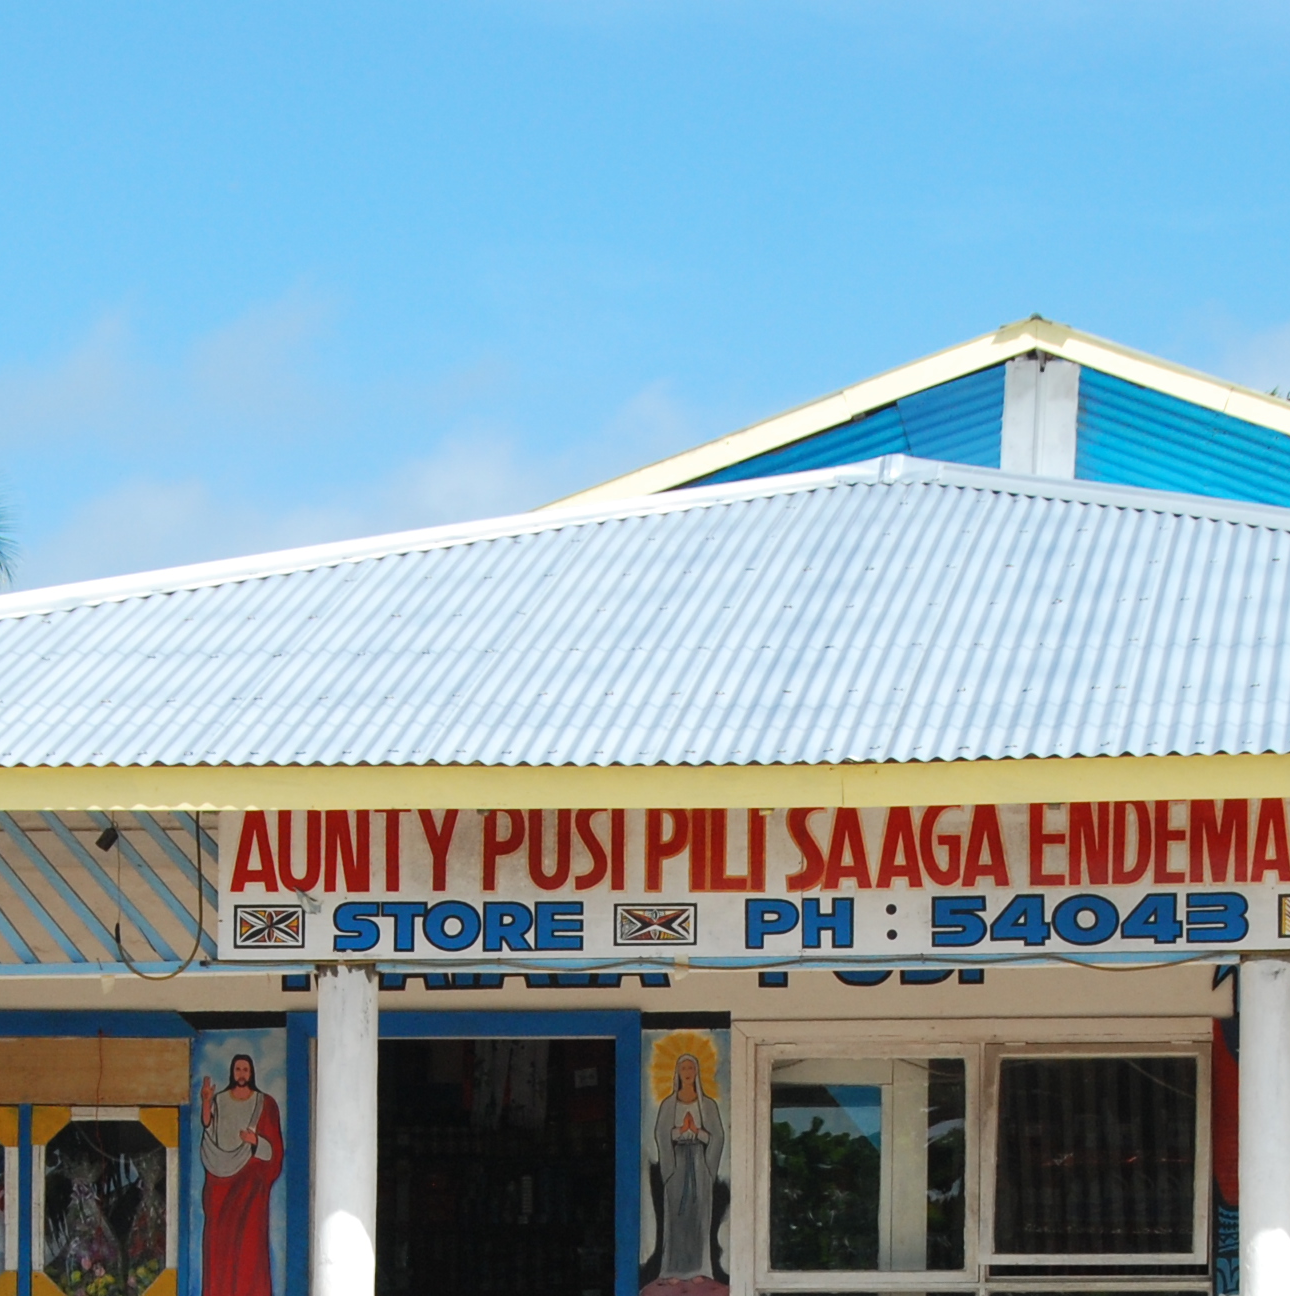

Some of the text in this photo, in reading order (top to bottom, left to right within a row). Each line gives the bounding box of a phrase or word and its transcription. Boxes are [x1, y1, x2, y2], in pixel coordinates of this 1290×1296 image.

[230, 809, 460, 893] AUNTY
[481, 808, 626, 892] PUSI
[645, 807, 767, 893] PILI
[785, 803, 1010, 892] SAAGA
[333, 900, 584, 953] STORE
[931, 892, 1249, 947] 54043
